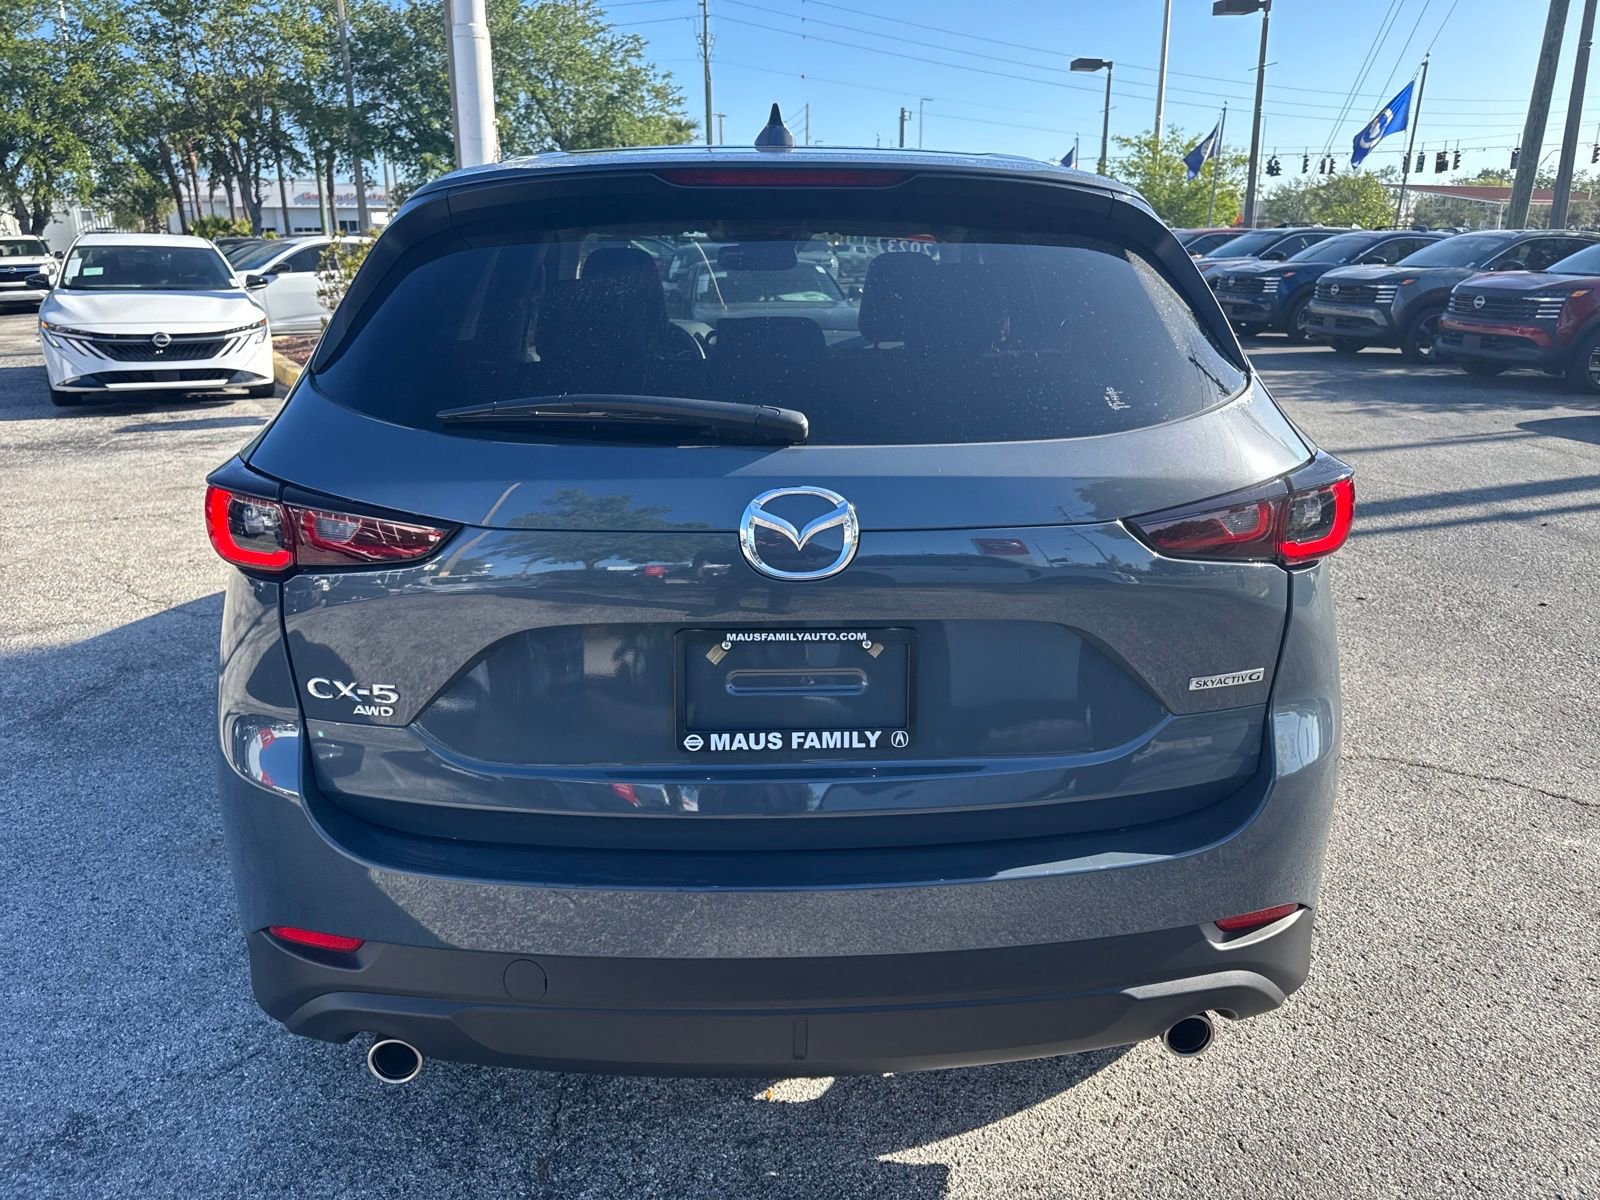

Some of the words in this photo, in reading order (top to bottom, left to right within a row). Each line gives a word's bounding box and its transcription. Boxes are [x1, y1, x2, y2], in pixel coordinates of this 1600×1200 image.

[726, 632, 867, 642] MAUSFAMILYAUTO.COM
[307, 677, 399, 704] CX-5
[353, 705, 394, 717] AWD
[710, 732, 783, 751] MAUS
[791, 731, 881, 749] FAMILY
